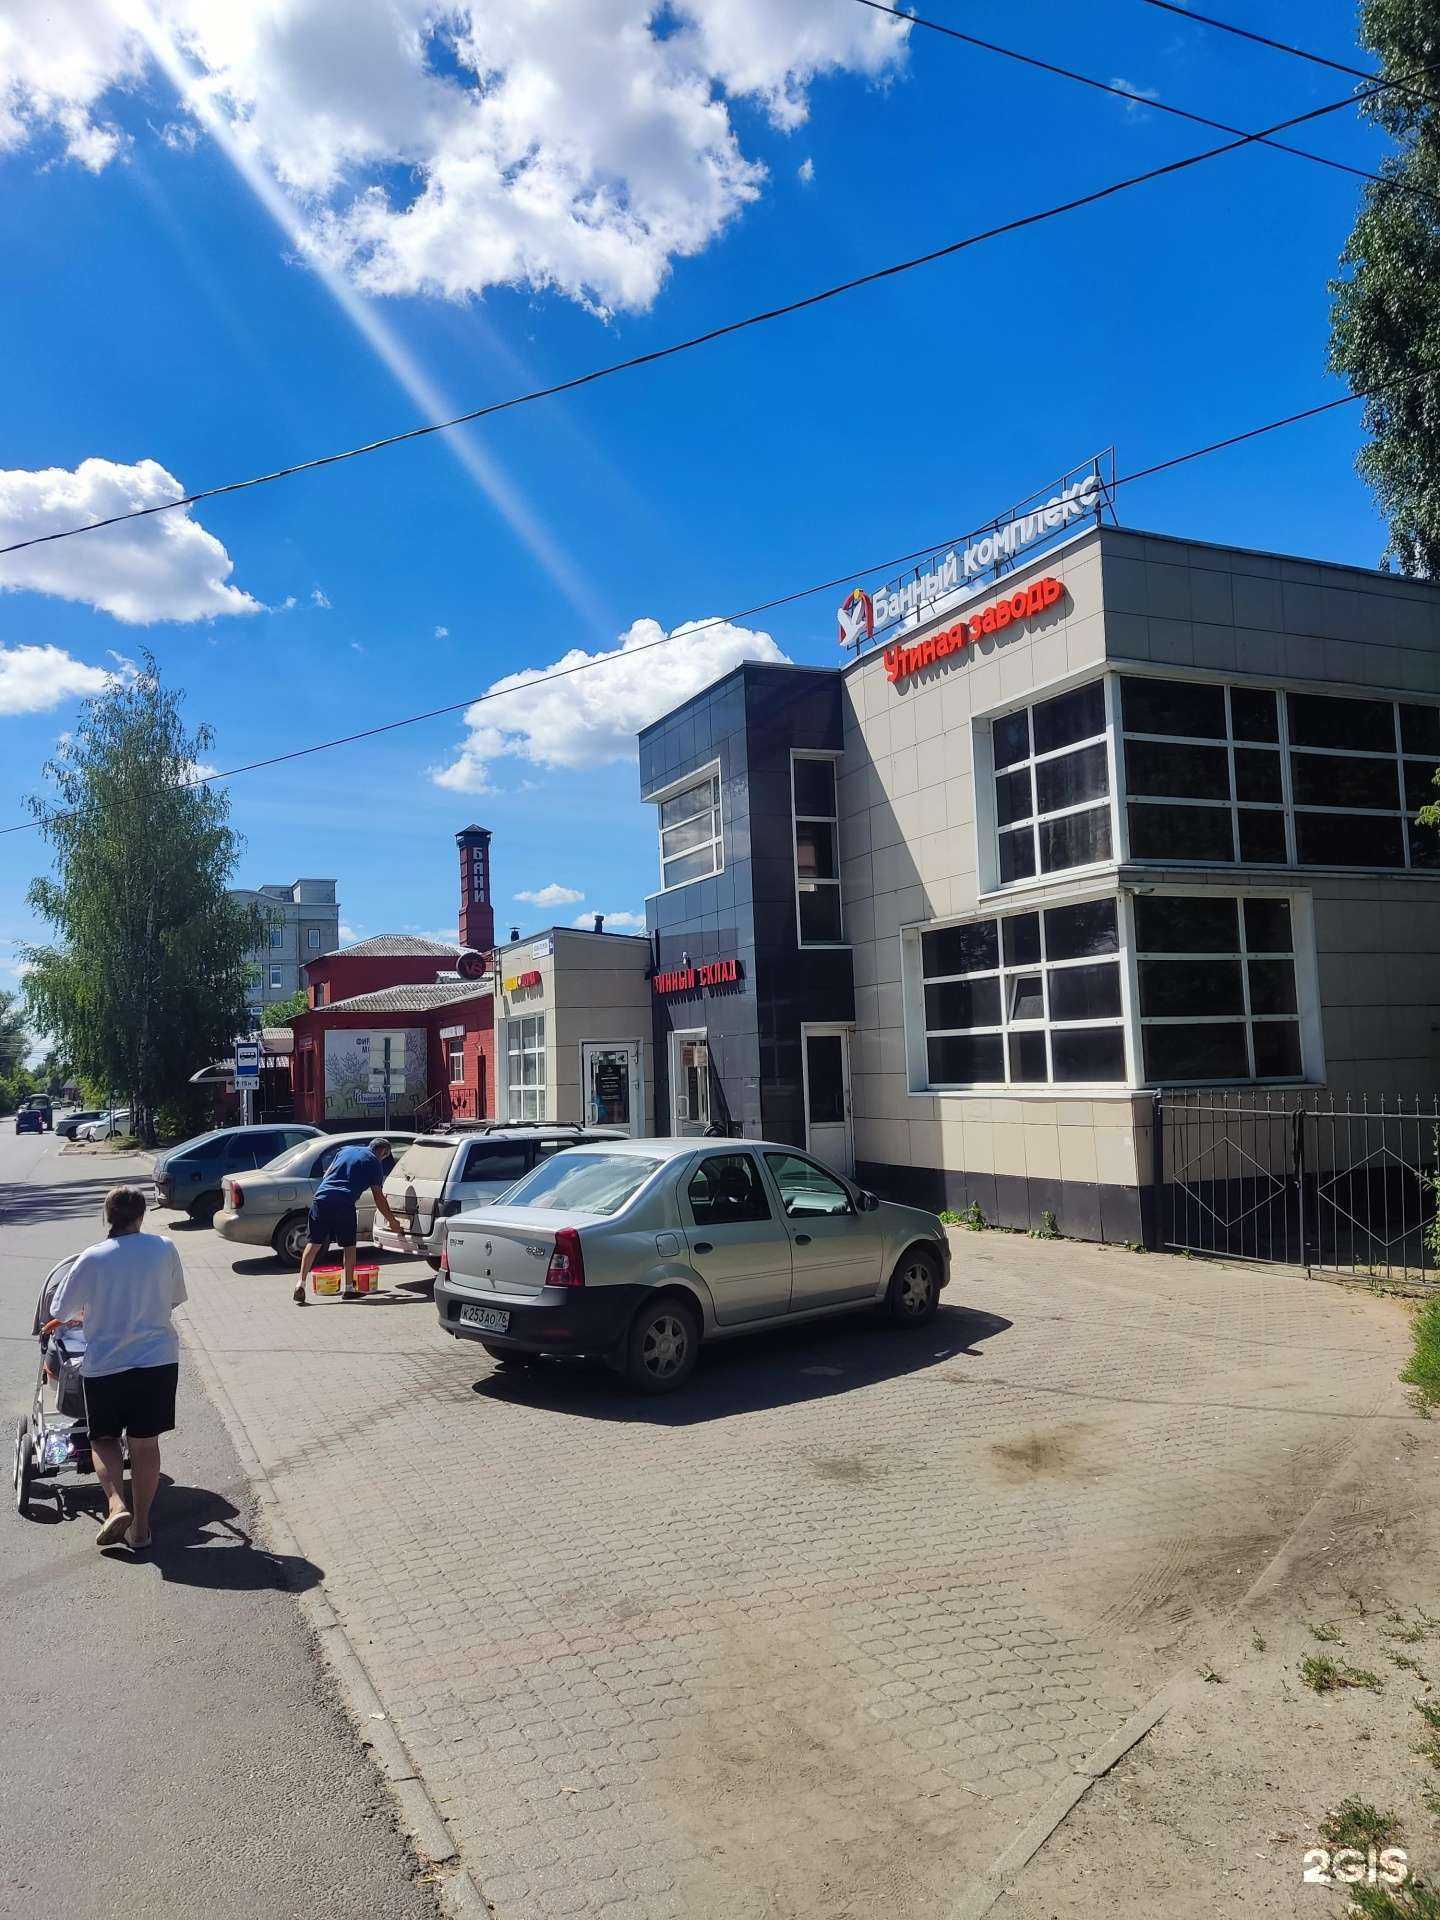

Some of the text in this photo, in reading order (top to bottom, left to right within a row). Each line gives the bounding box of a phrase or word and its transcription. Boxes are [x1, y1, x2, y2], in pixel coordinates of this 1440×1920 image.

[872, 475, 1100, 627] Банный комплекс
[883, 577, 1065, 683] Утиная заводь
[472, 847, 485, 903] БАНИ
[699, 960, 737, 987] СКЛАД
